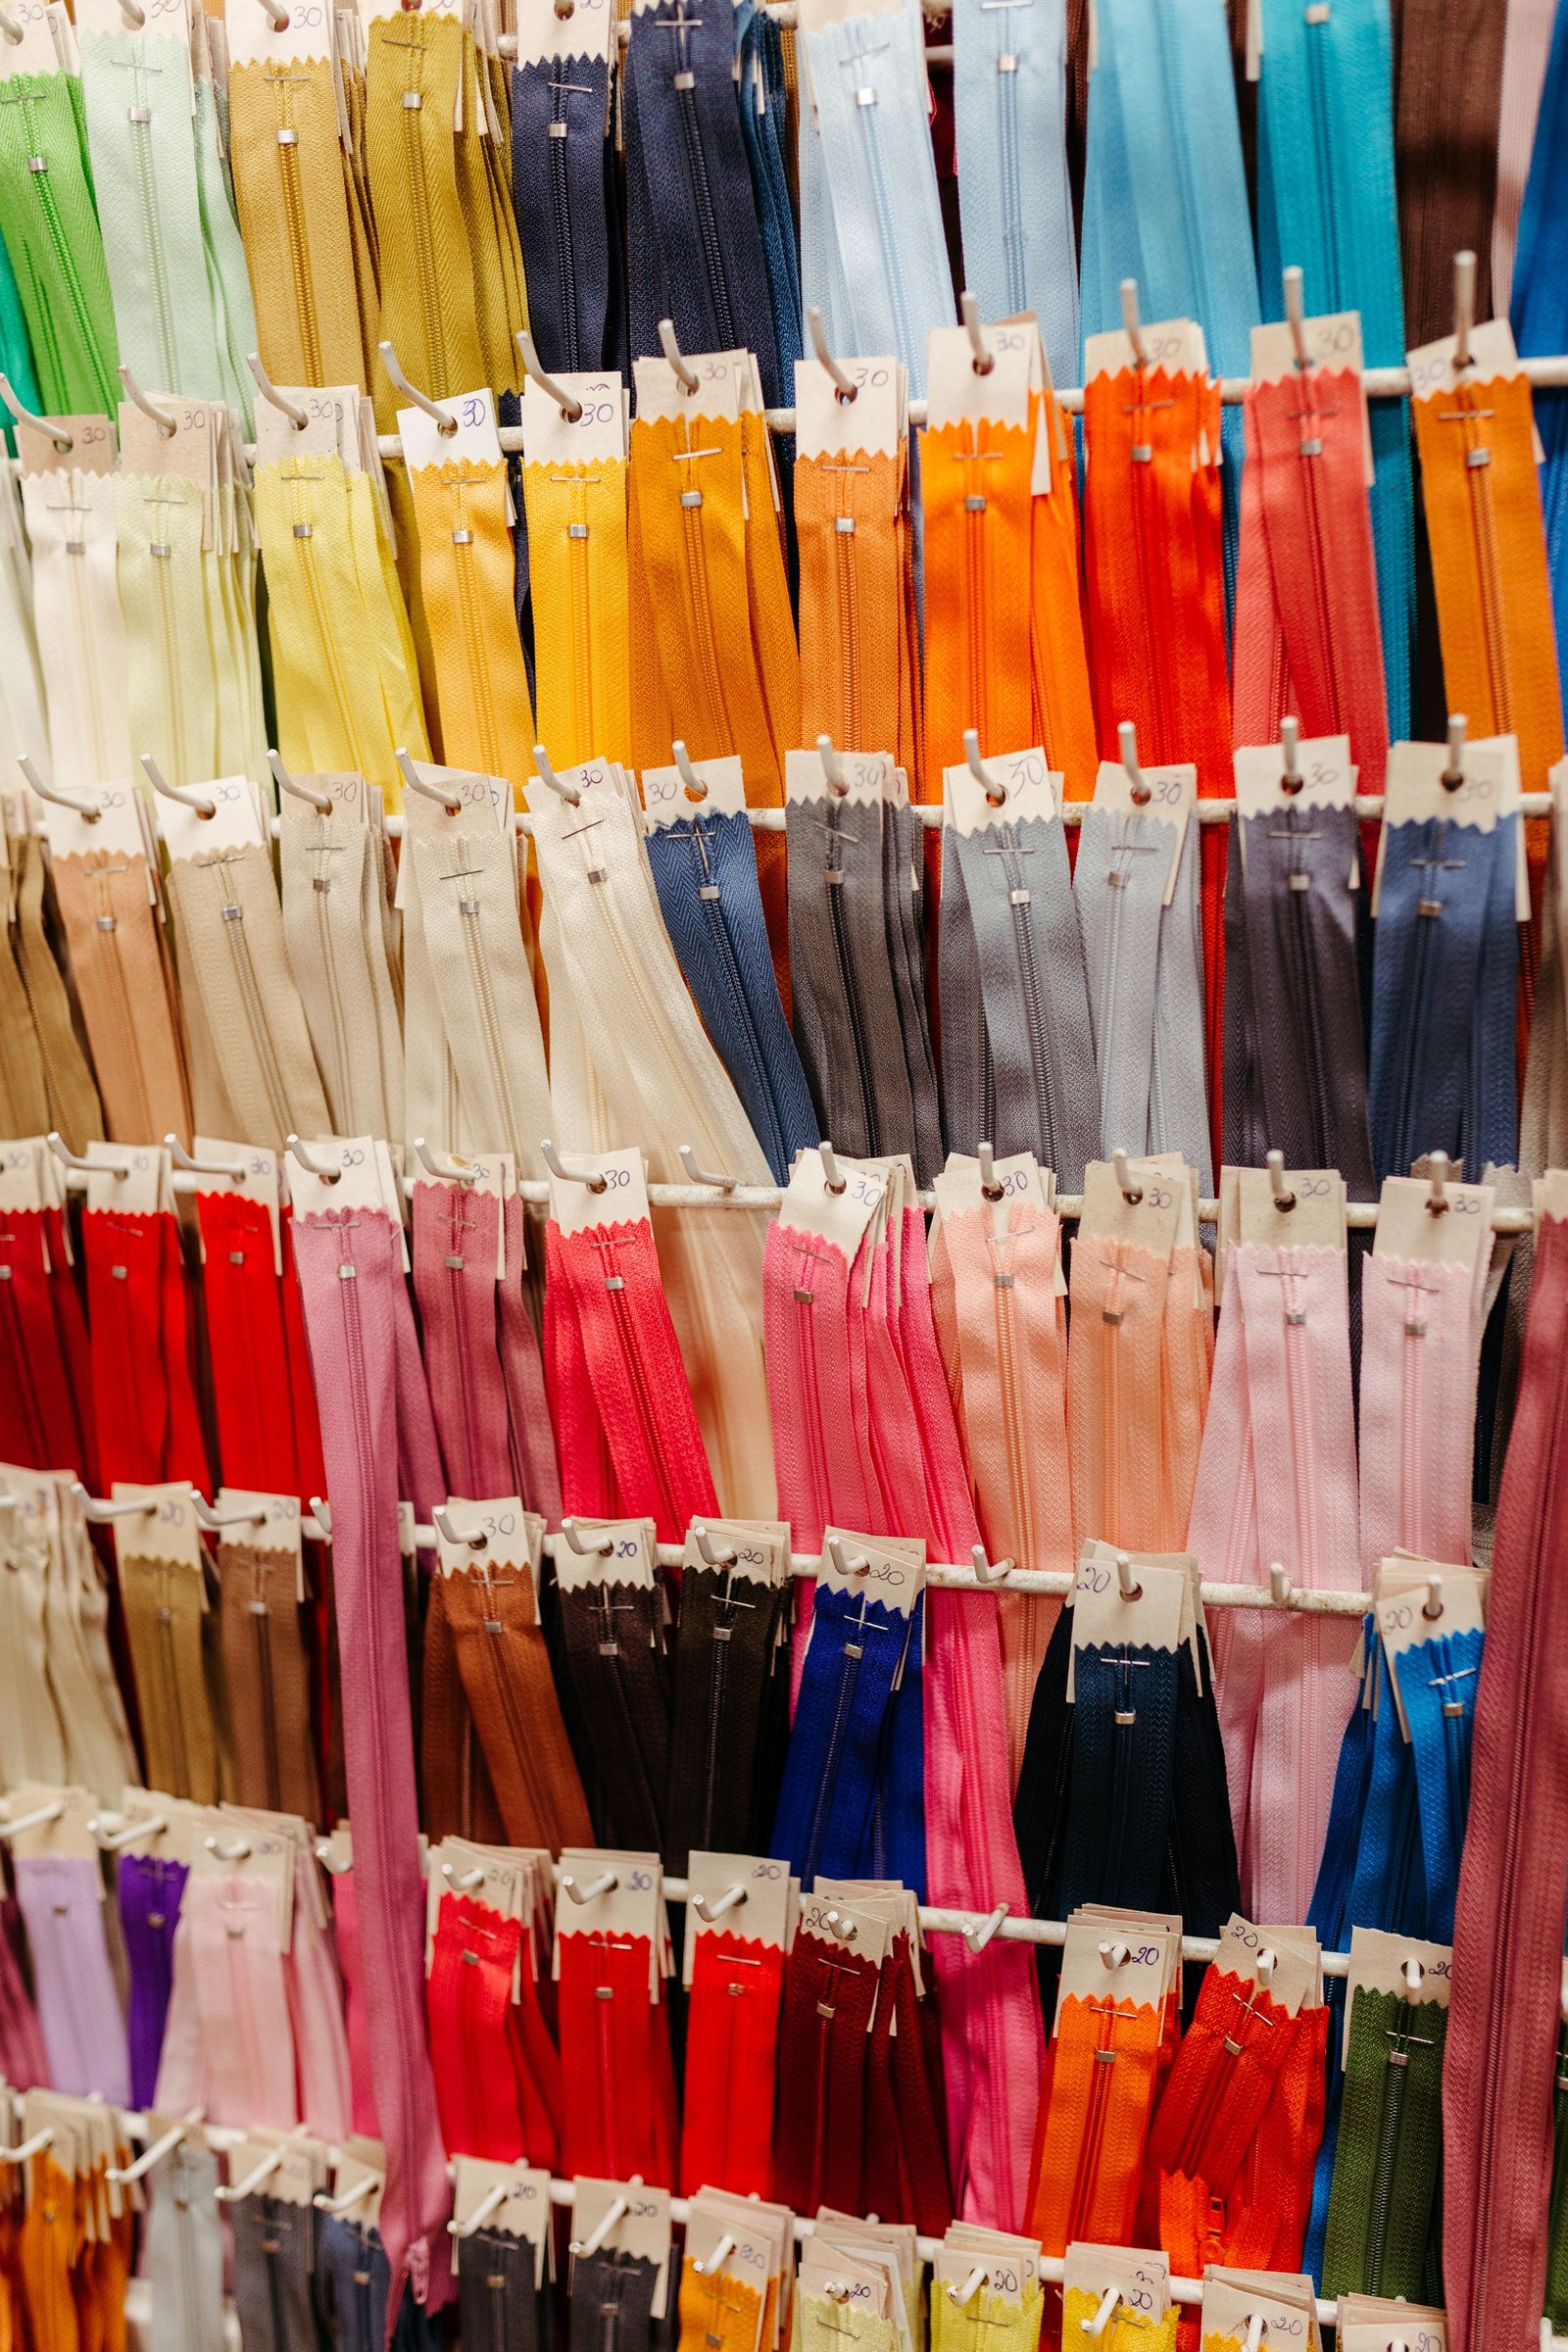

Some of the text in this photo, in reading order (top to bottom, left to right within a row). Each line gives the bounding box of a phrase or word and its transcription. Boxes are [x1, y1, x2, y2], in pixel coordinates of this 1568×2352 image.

[20, 3, 47, 24] 30
[294, 7, 322, 28] 30
[996, 332, 1025, 352] 30
[1151, 337, 1183, 360] 30
[1318, 323, 1353, 355] 30
[703, 361, 727, 381] 30
[856, 368, 889, 388] 30
[1415, 359, 1446, 390] 30
[311, 399, 334, 419] 30
[463, 398, 486, 428] 30
[580, 403, 613, 429] 30
[183, 410, 206, 431] 30
[82, 426, 106, 445] 30
[580, 768, 604, 789] 30
[854, 762, 880, 787] 30
[1008, 756, 1045, 799] 30
[1305, 762, 1339, 789] 30
[101, 791, 125, 808] 30
[217, 785, 241, 803] 30
[332, 781, 357, 803] 30
[462, 782, 486, 807] 30
[649, 782, 678, 805] 30
[1152, 781, 1182, 805] 30
[1459, 780, 1494, 804] 30
[251, 1156, 271, 1176] 30
[341, 1149, 366, 1168] 30
[473, 1162, 491, 1181] 30
[605, 1169, 630, 1190] 30
[852, 1180, 882, 1206] 30
[1002, 1170, 1029, 1197] 30
[1300, 1177, 1331, 1199] 30
[1148, 1187, 1173, 1209] 30
[1454, 1194, 1481, 1215] 30
[481, 1514, 516, 1540] 30
[616, 1542, 638, 1559] 20
[738, 1546, 764, 1565] 20
[869, 1563, 906, 1586] 20
[1076, 1567, 1111, 1594] 20
[1383, 1606, 1413, 1638] 20
[751, 1865, 782, 1881] 20
[1230, 1925, 1258, 1949] 20
[1131, 1947, 1159, 1967] 20
[512, 2181, 537, 2201] 20
[630, 2201, 659, 2217] 20
[849, 2282, 871, 2299] 20
[994, 2268, 1018, 2293] 20
[1129, 2288, 1153, 2310] 20
[1270, 2316, 1303, 2336] 20
[1414, 2331, 1443, 2352] 20
